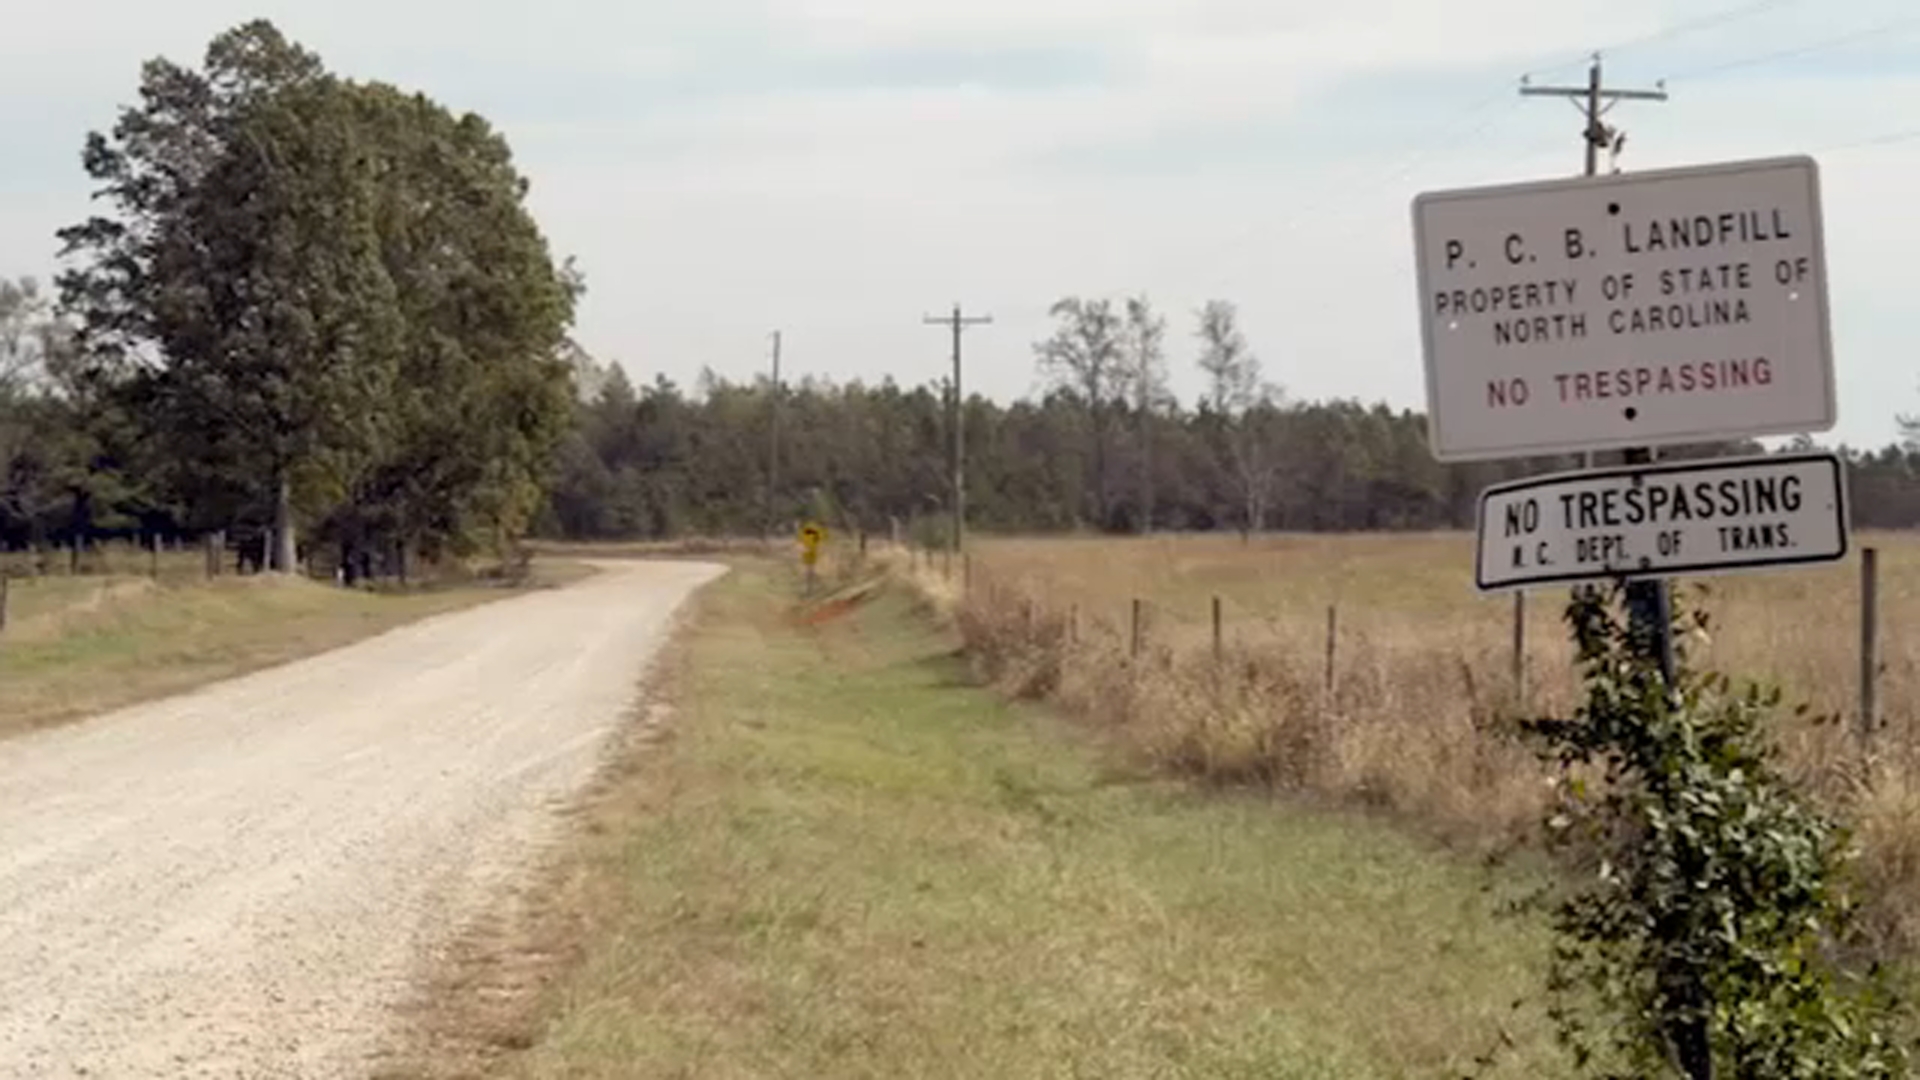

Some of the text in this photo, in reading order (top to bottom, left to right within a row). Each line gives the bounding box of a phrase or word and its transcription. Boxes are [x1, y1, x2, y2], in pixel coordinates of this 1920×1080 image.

[1446, 208, 1791, 269] P. C. B. LANDFILL
[1435, 257, 1810, 315] PROPERTY OF STATE OF
[1494, 299, 1751, 345] NORTH CAROLINA
[1487, 357, 1773, 407] NO TRESPASSING
[1504, 475, 1802, 536] NO TRESPASSING
[1536, 541, 1554, 566] C.
[1577, 535, 1629, 562] DEPT.
[1658, 531, 1683, 557] OF
[1719, 523, 1798, 552] TRANS.
